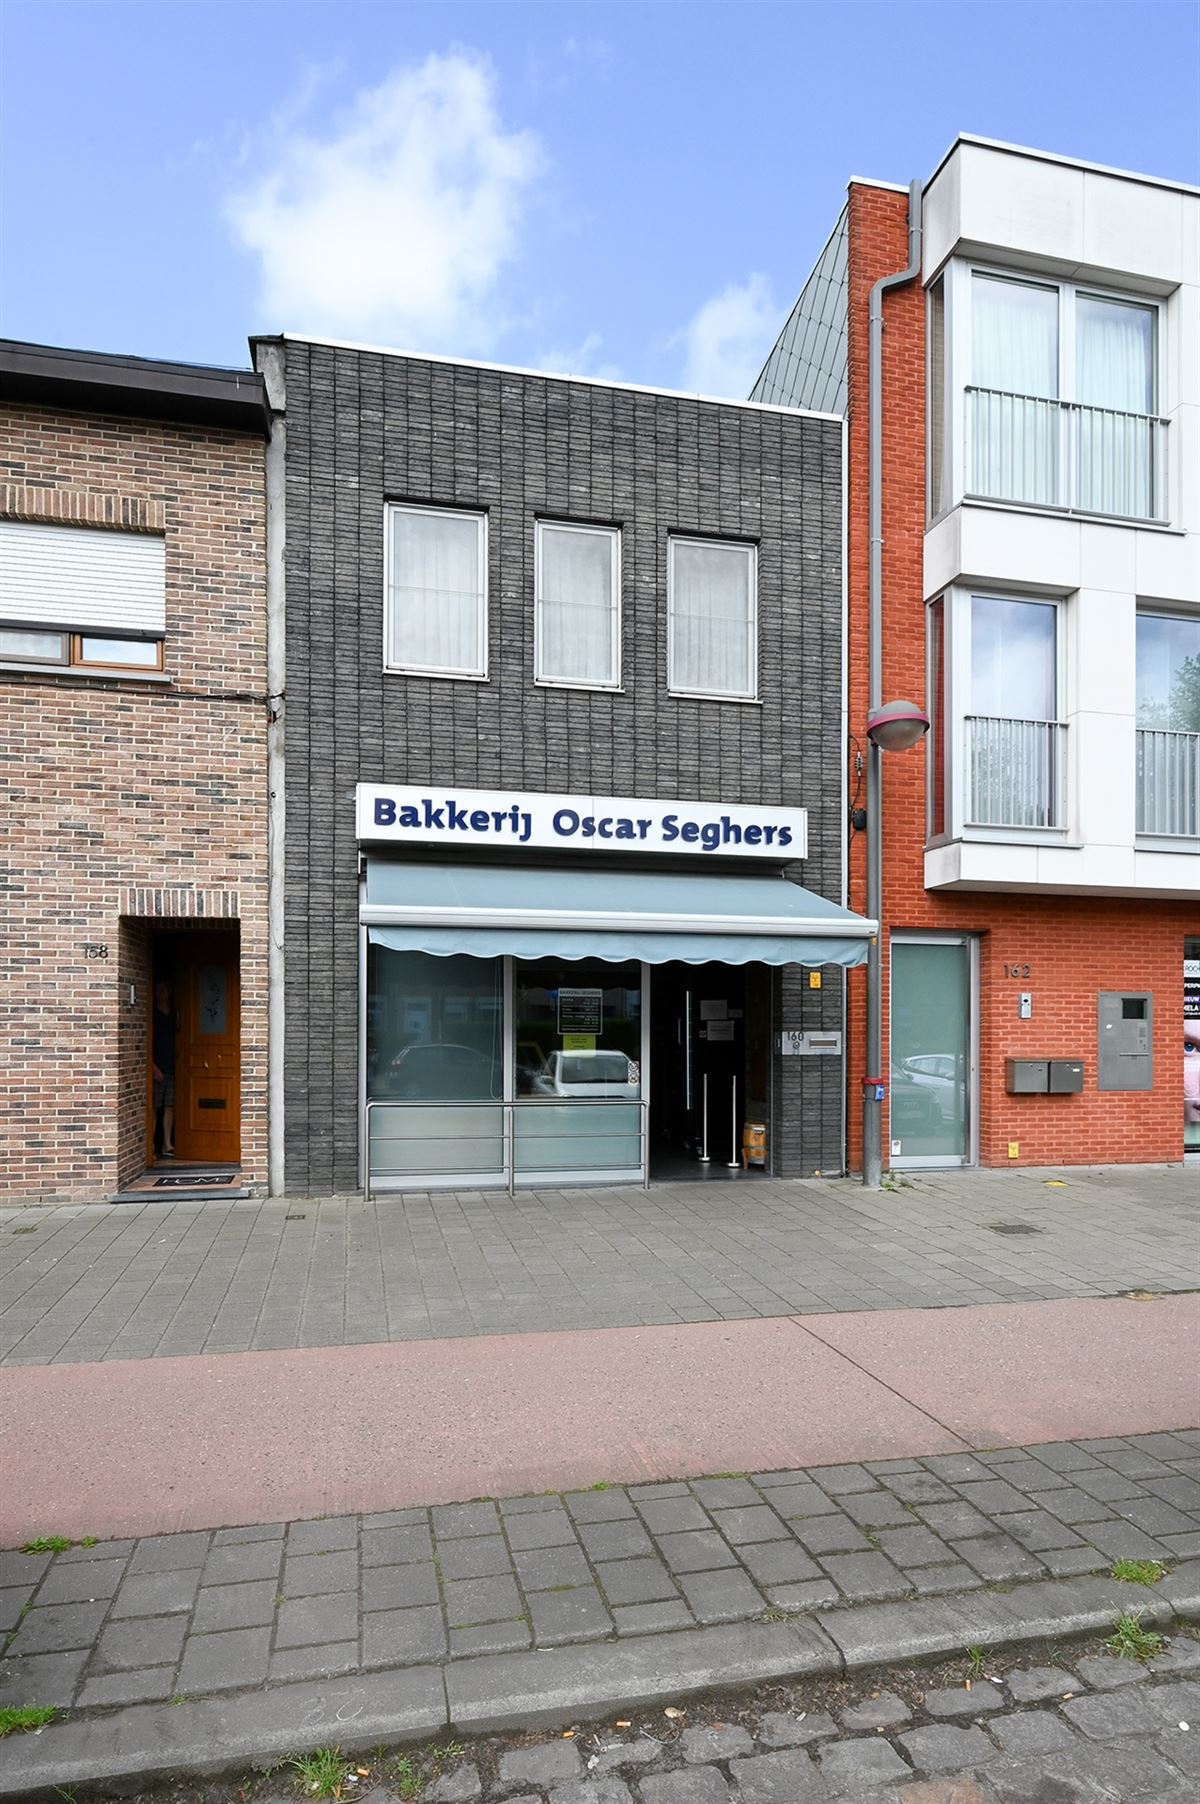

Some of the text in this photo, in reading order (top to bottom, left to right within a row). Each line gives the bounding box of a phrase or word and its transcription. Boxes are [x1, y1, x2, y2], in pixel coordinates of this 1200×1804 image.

[374, 797, 793, 851] Bakkerij Oscar Seghers
[84, 945, 108, 959] 158
[1003, 963, 1031, 979] 162
[787, 1031, 804, 1041] 160
